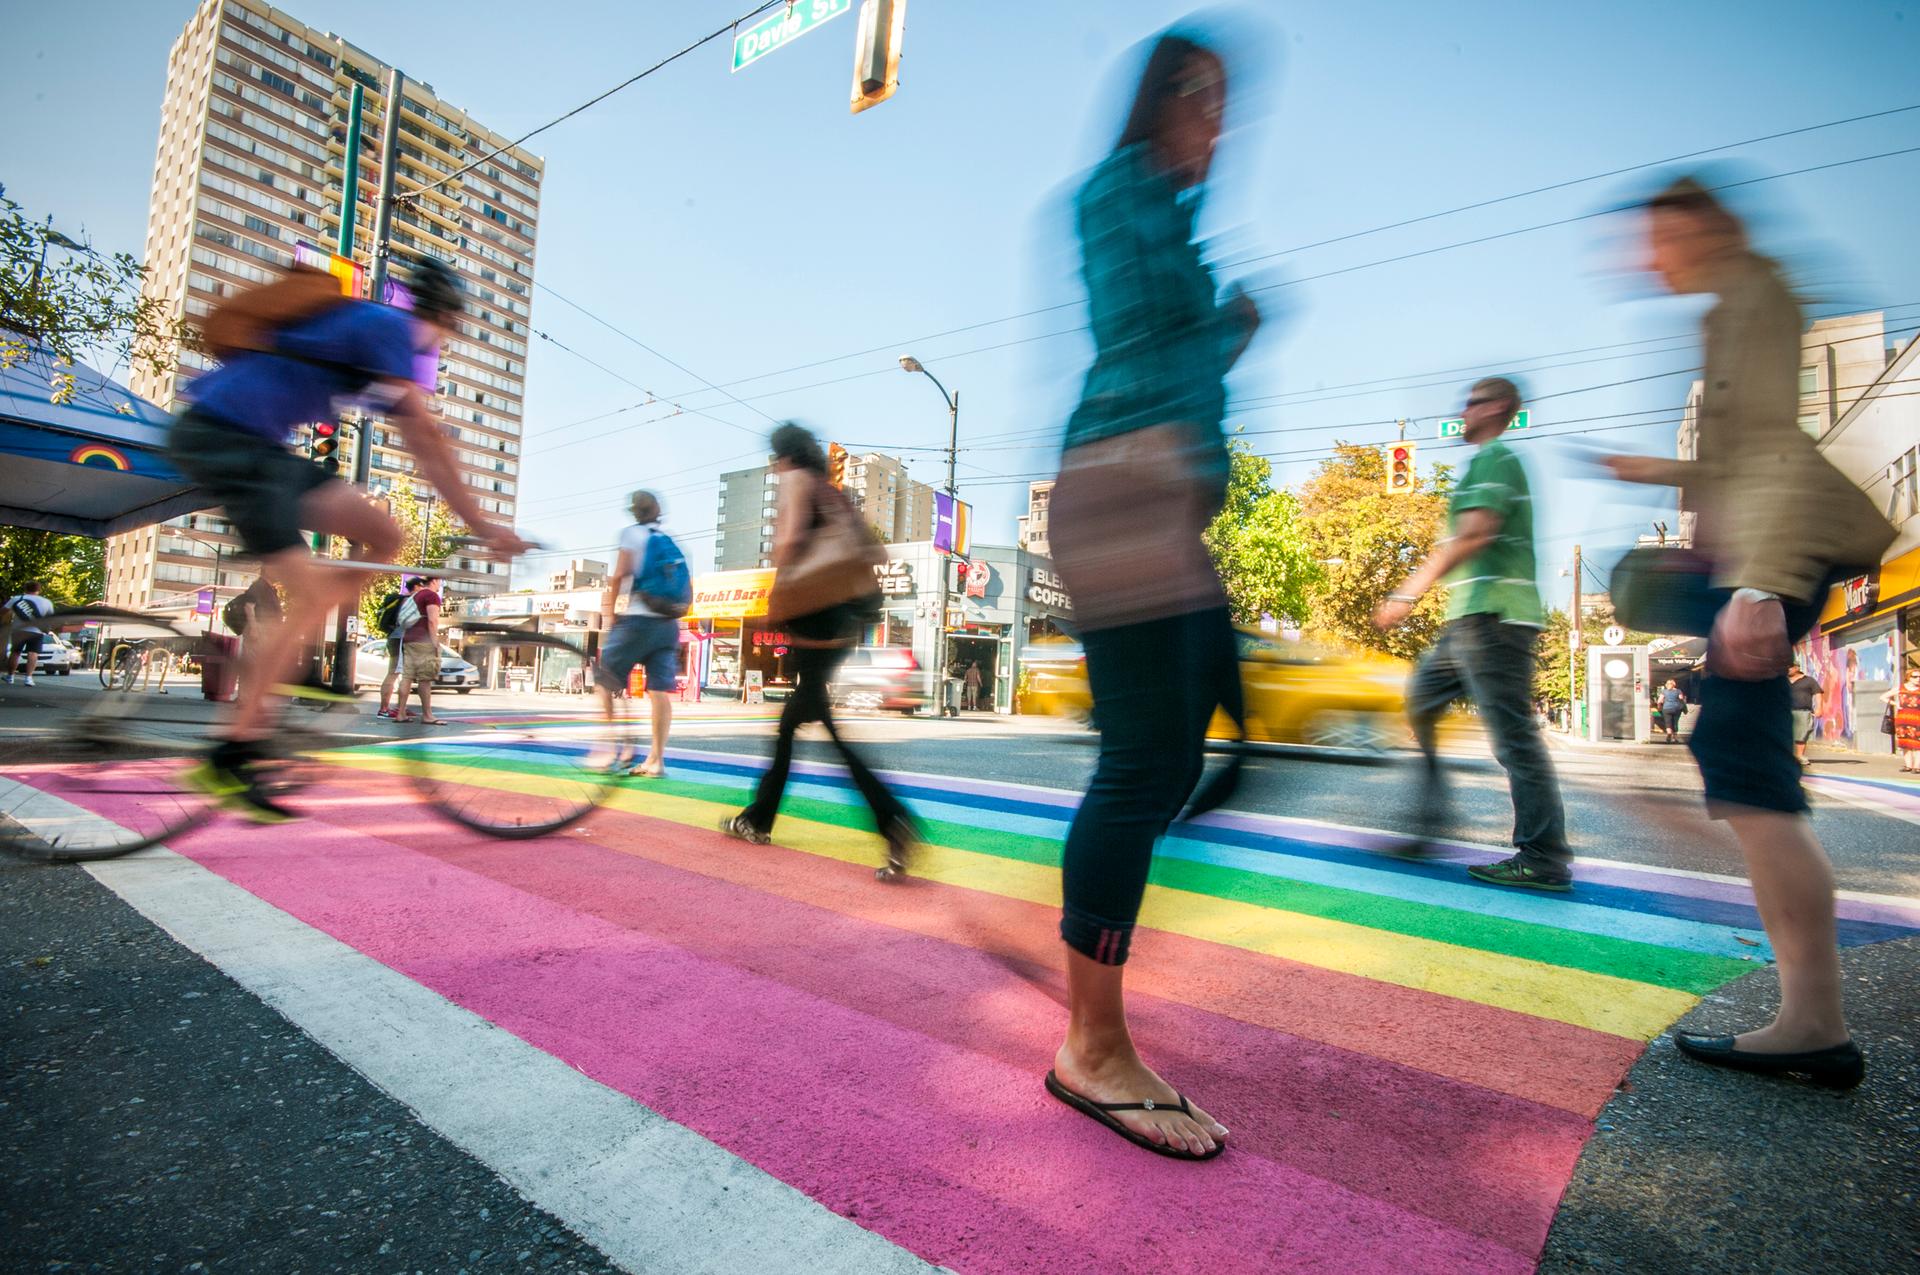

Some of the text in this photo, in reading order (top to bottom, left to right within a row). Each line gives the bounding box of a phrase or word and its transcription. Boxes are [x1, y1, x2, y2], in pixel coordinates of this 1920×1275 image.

[742, 12, 802, 61] Davie
[1033, 568, 1065, 589] BLE
[733, 589, 757, 601] Bar
[1029, 586, 1073, 609] COFFE
